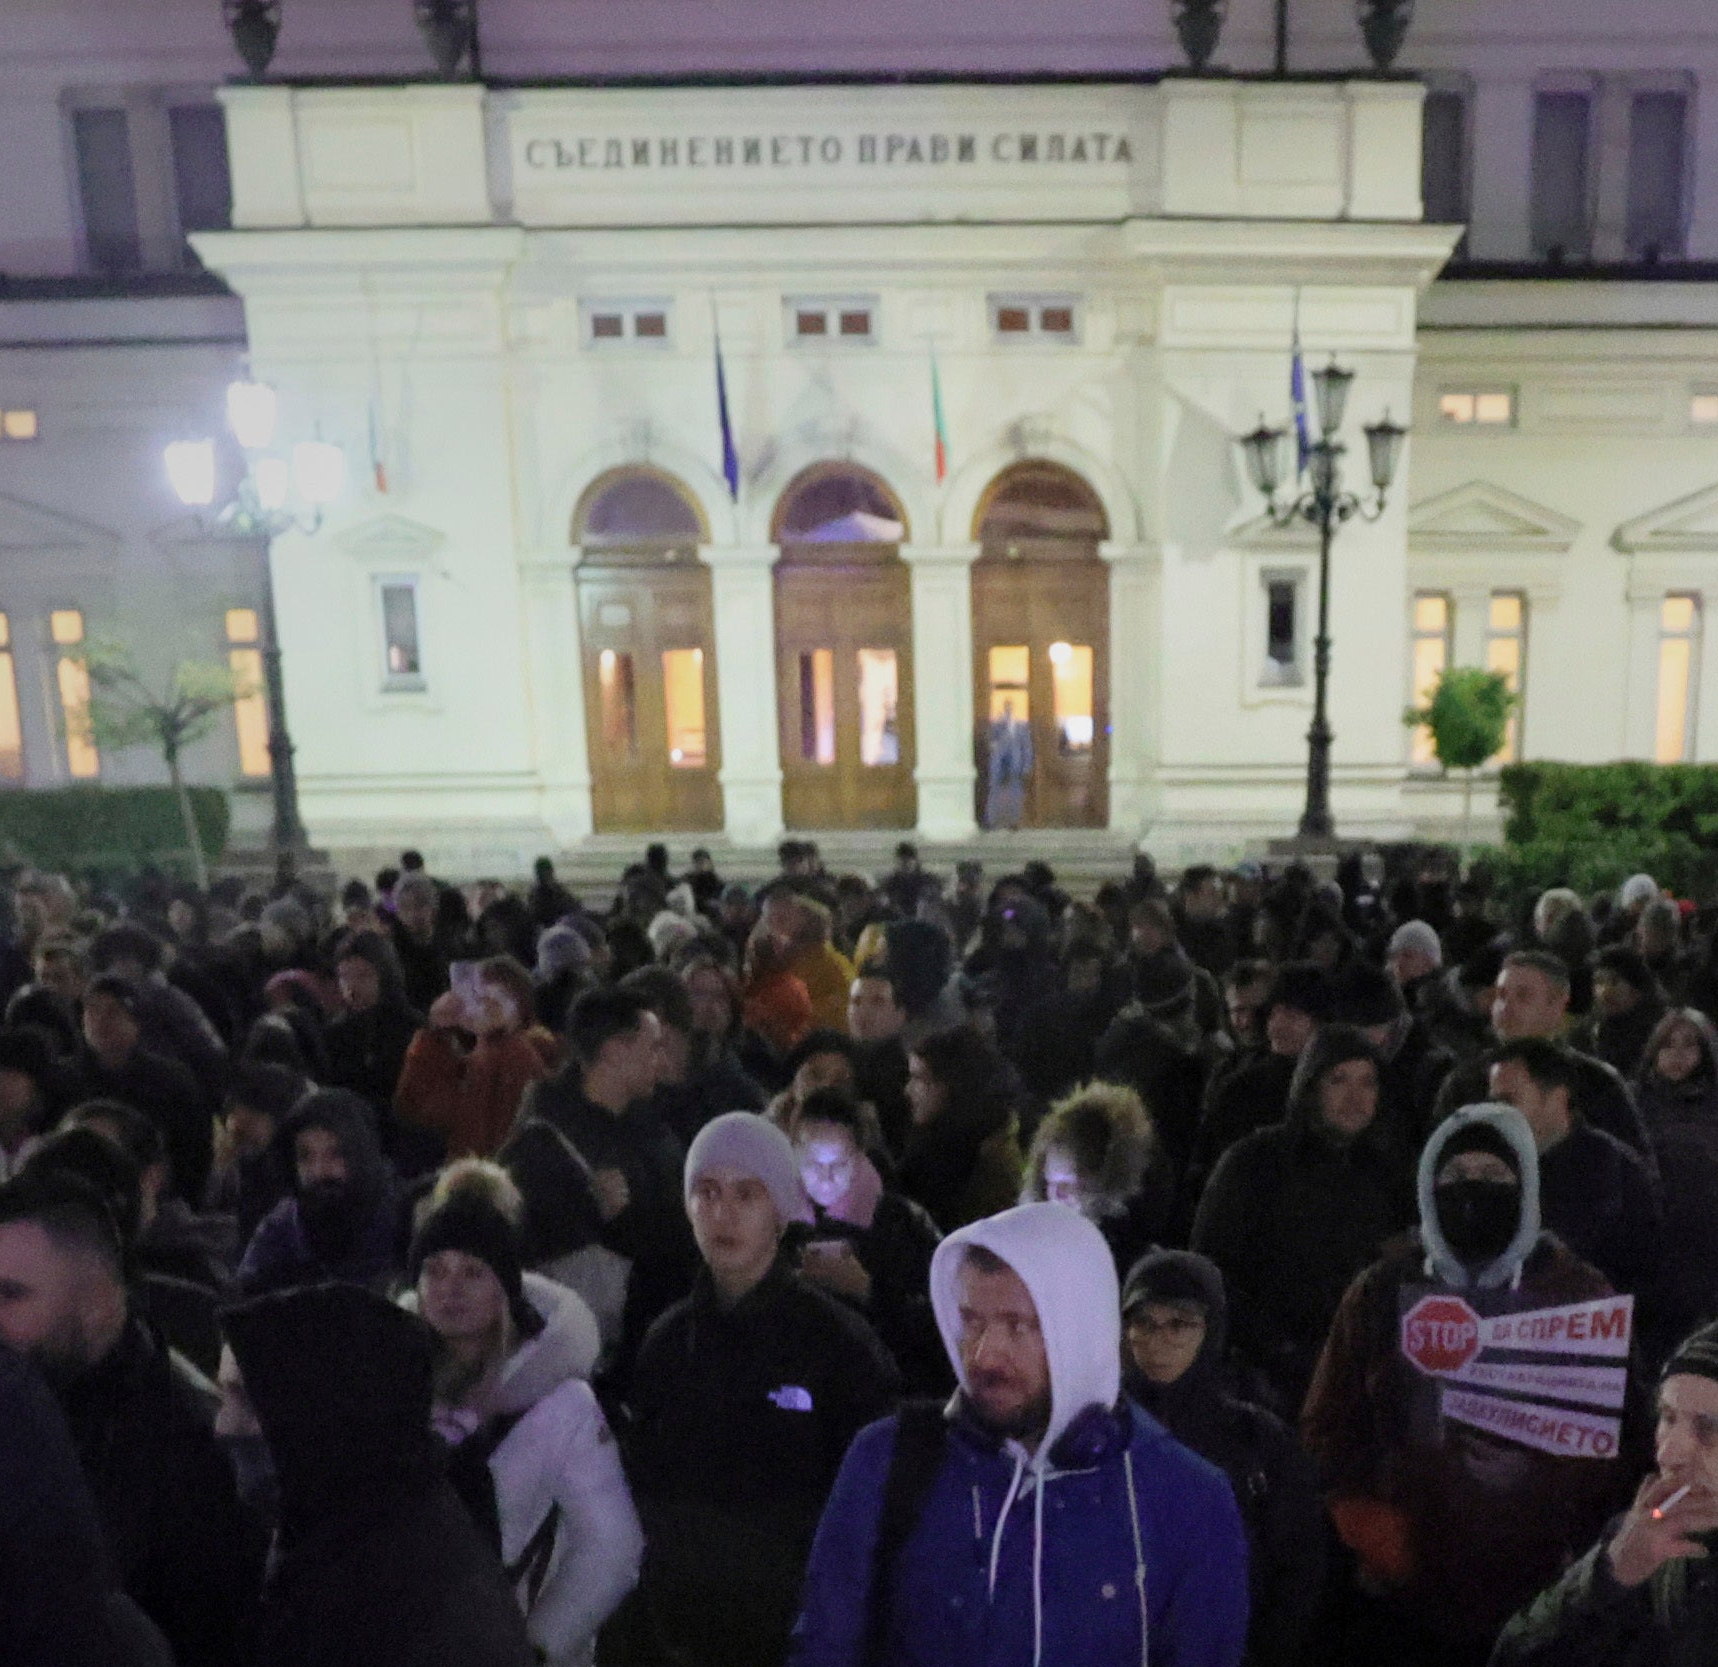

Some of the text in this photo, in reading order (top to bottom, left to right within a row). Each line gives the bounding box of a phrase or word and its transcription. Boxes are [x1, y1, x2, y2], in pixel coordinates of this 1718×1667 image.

[524, 132, 1134, 169] СЪЕДИНЕНИЕТО ПРАВИ СИЛАТА
[1406, 1319, 1478, 1351] STOP
[1517, 1307, 1628, 1341] СПРЕМ
